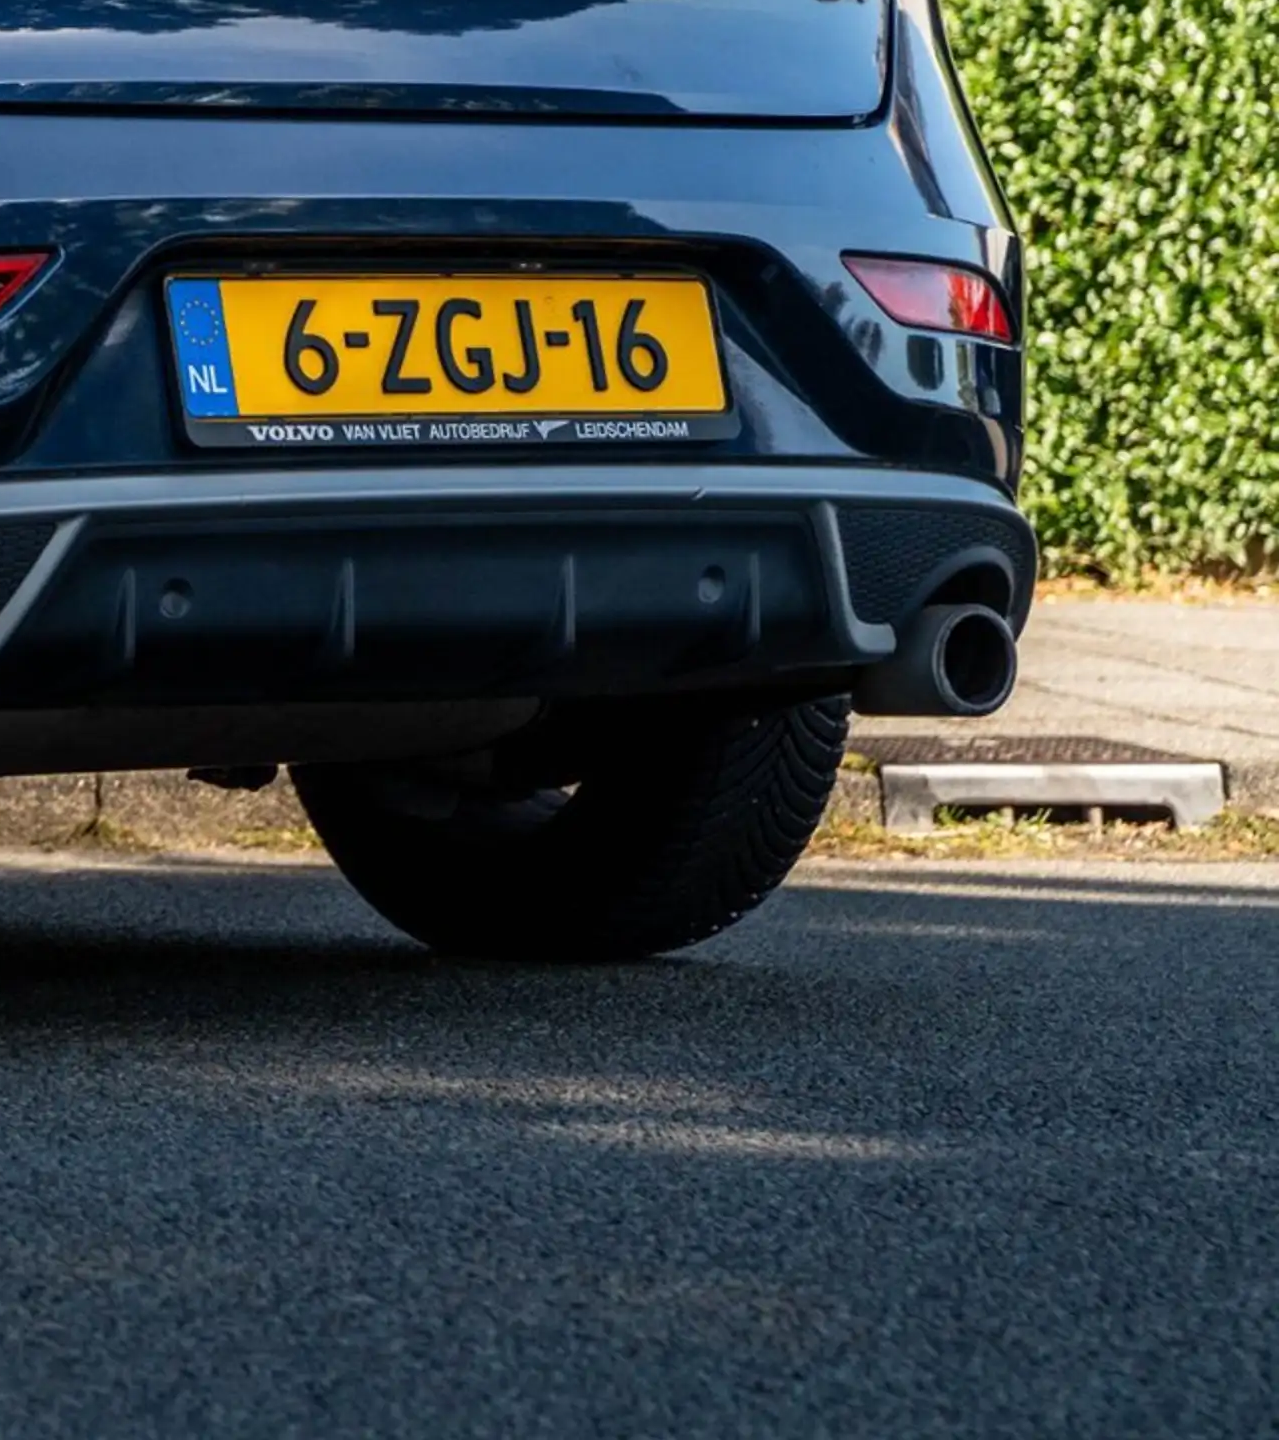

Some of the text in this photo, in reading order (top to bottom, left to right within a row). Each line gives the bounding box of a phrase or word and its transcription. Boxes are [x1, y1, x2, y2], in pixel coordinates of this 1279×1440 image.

[283, 297, 670, 397] 6-ZGJ-16
[187, 364, 229, 395] NL
[247, 420, 690, 442] VOLVO VAN VLIET AUTOBEDRIJF LEIDSCHENDAM
